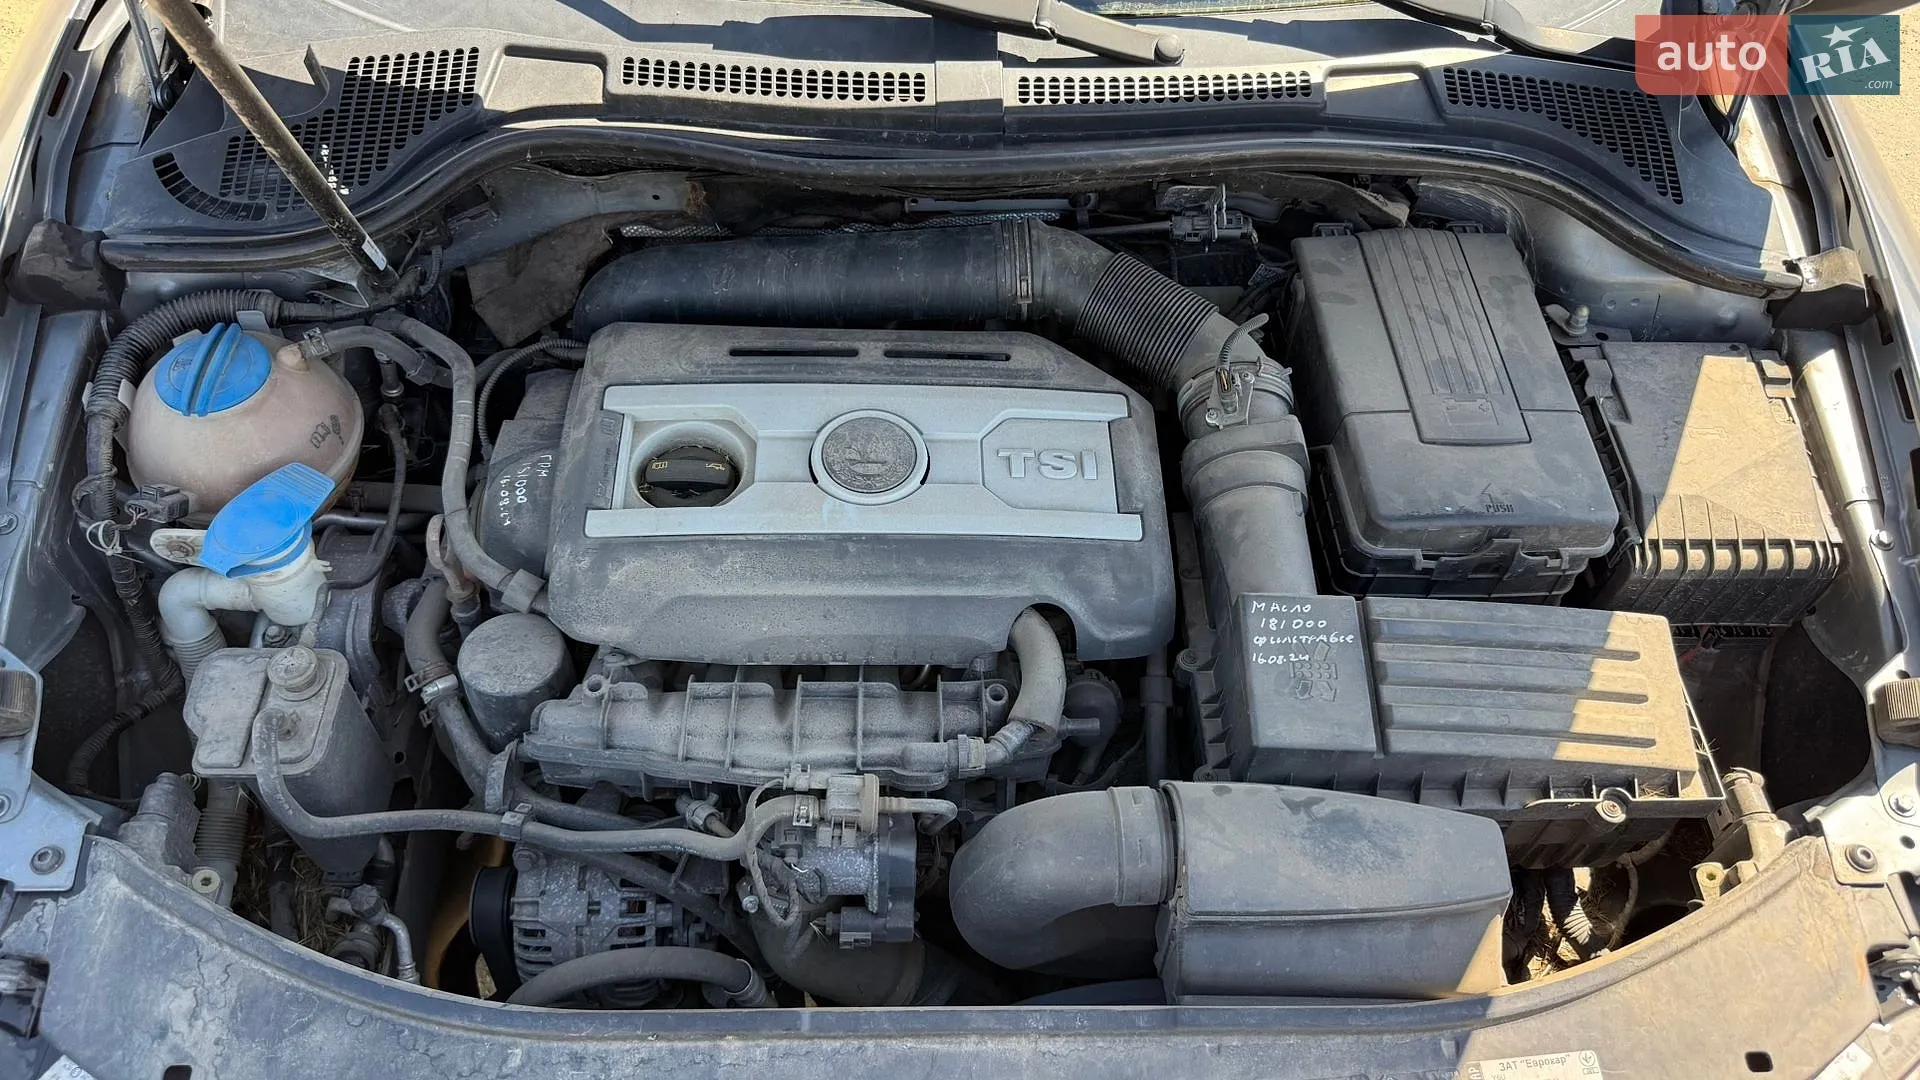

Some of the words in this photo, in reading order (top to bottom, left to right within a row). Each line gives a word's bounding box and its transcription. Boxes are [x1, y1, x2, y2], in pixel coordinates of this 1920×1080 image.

[997, 448, 1099, 481] TSI
[1485, 503, 1515, 513] PUSH
[1260, 617, 1328, 631] 181000
[1498, 1060, 1519, 1072] ЗАТ
